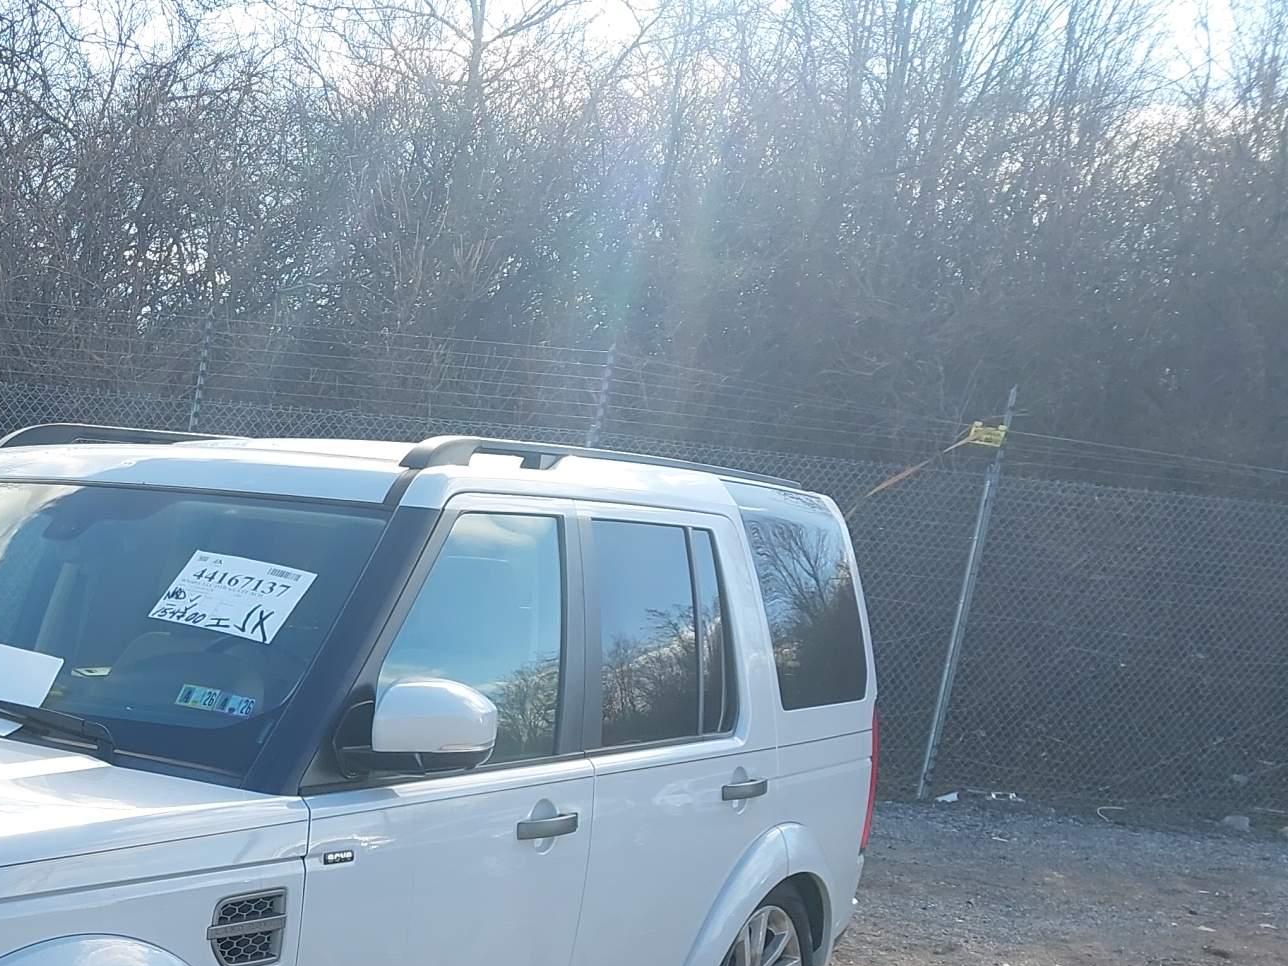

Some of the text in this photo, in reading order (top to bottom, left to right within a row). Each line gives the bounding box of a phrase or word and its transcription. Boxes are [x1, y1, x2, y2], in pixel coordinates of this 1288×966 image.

[193, 568, 291, 597] 44167137
[203, 691, 216, 706] 26
[240, 699, 254, 714] 26
